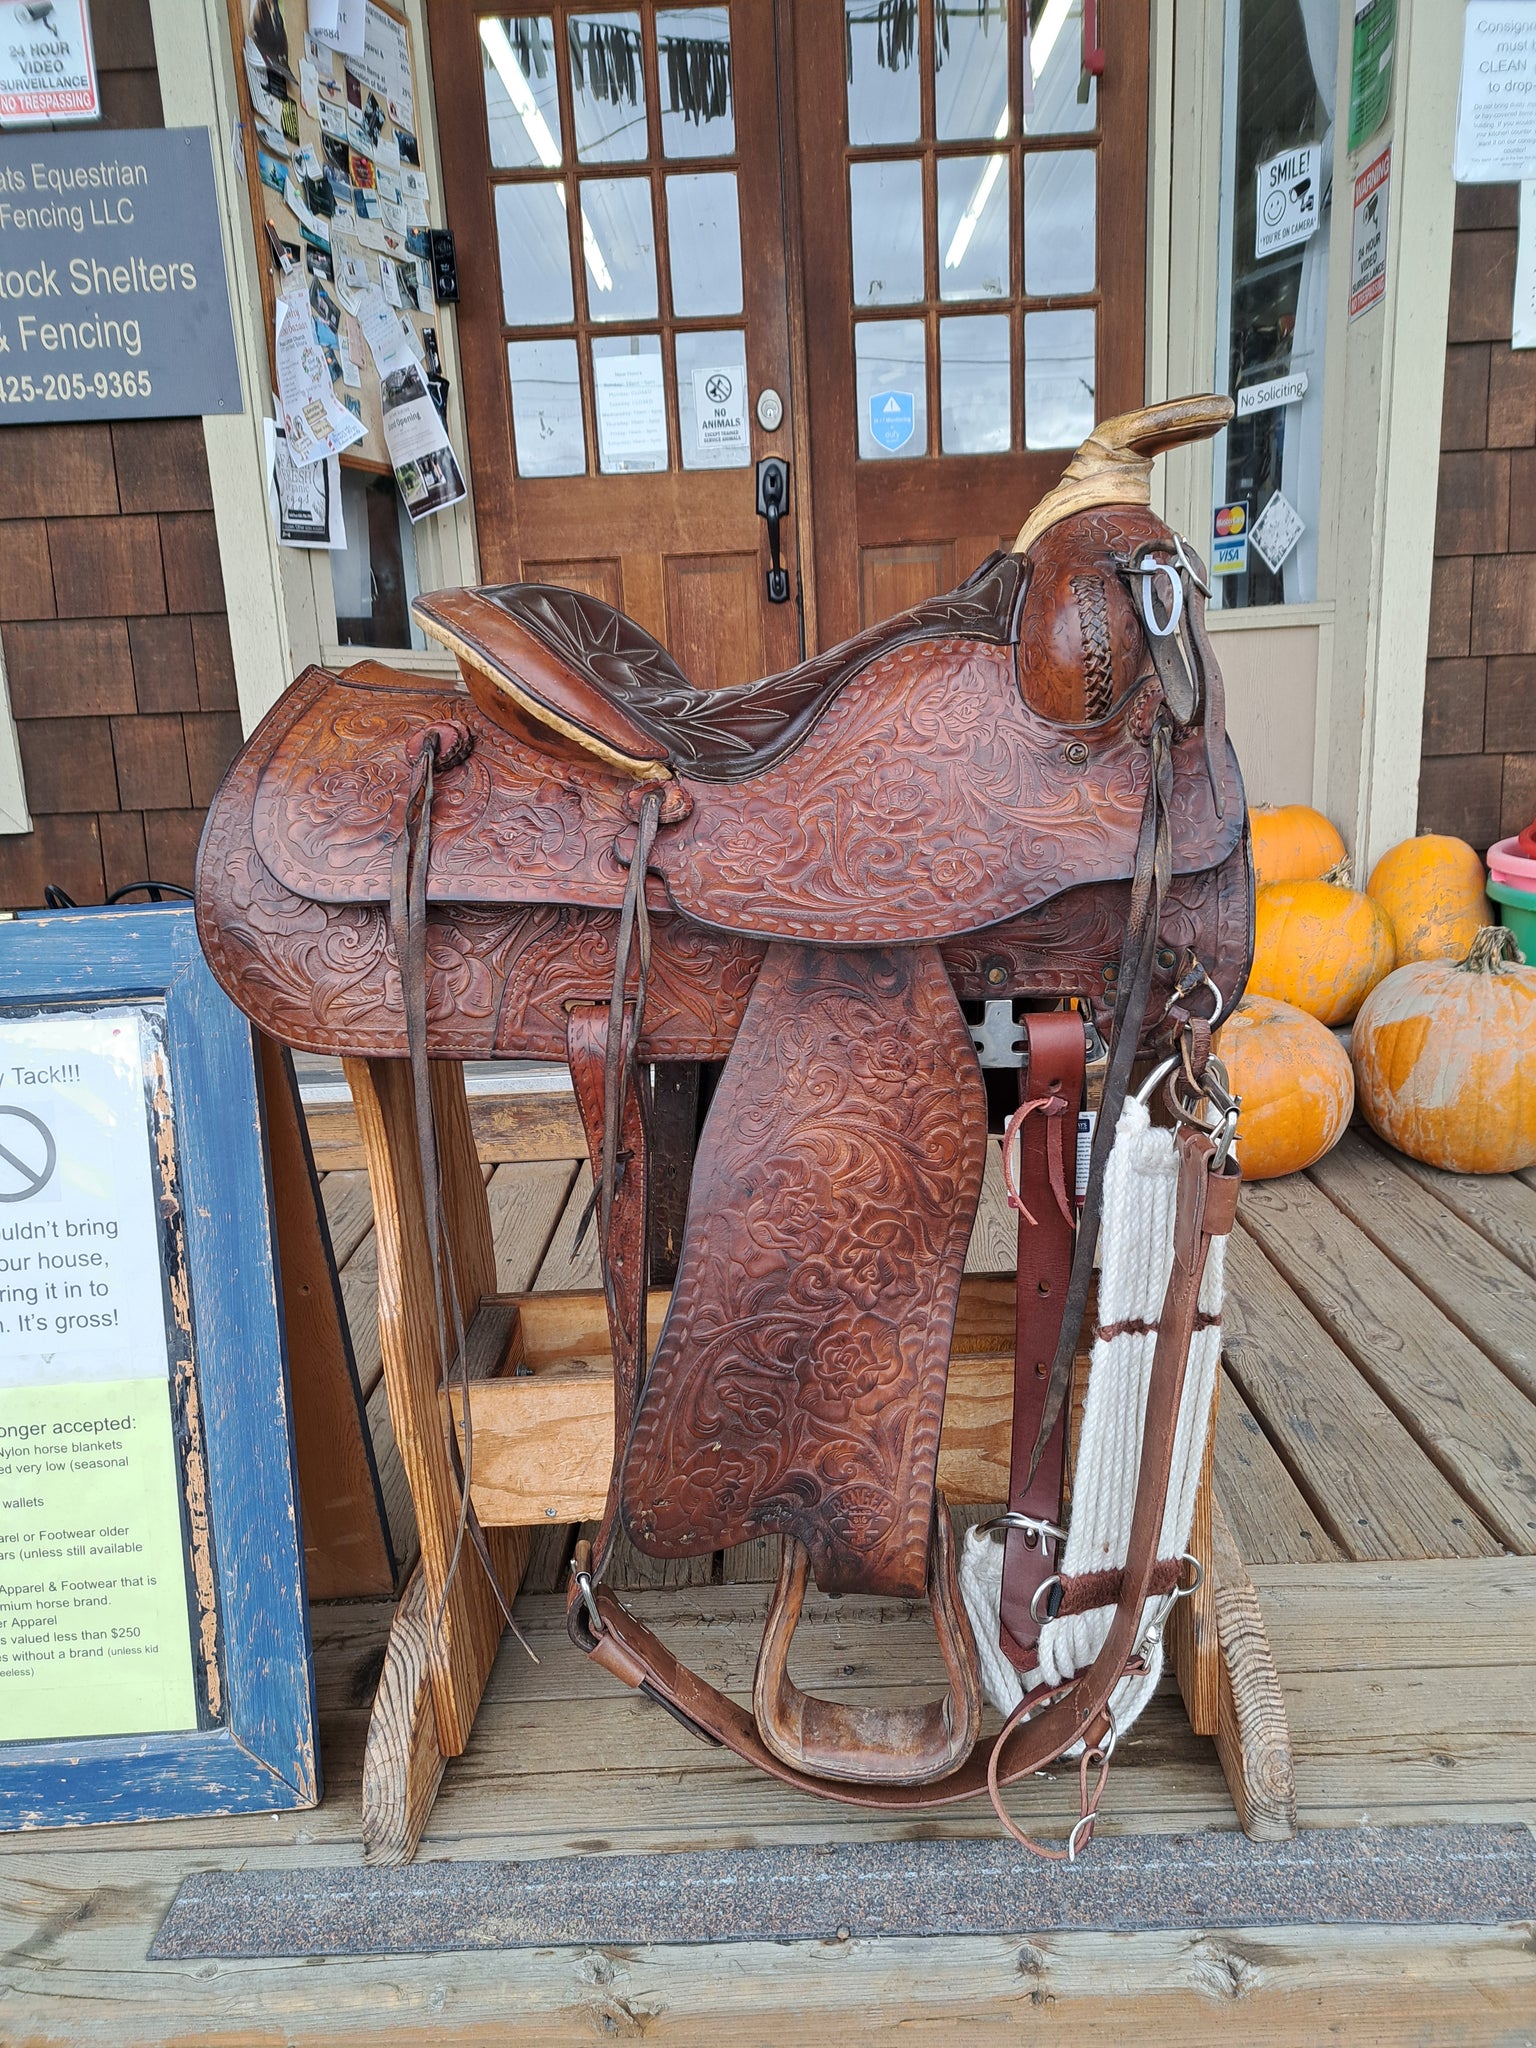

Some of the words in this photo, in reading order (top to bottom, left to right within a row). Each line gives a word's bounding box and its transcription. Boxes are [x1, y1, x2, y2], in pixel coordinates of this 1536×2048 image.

[9, 44, 26, 58] 24
[30, 42, 71, 57] HOUR
[1497, 40, 1527, 52] must
[18, 60, 64, 74] VIDEO
[1480, 60, 1528, 73] CLEAN
[0, 76, 88, 90] SURVEILLANCE
[1489, 81, 1500, 92] to
[1, 96, 16, 113] NO
[18, 92, 92, 113] TRESPASSING
[31, 160, 150, 196] Equestrian
[1270, 150, 1310, 188] SMILE!
[1355, 156, 1390, 202] WARNING
[0, 201, 84, 232] Fencing
[89, 198, 135, 226] LLC
[1358, 248, 1364, 260] 24
[1366, 232, 1381, 254] HOUR
[1360, 252, 1378, 275] VIDEO
[68, 256, 198, 296] Shelters
[1352, 261, 1386, 295] SURVEILLANCE
[18, 312, 142, 357] Fencing
[1241, 395, 1255, 408] No
[1258, 381, 1304, 404] Soliciting
[714, 408, 726, 418] NO
[702, 417, 741, 430] ANIMALS
[1218, 548, 1240, 562] VISA
[11, 1064, 80, 1085] Tack!!!
[66, 1218, 118, 1239] bring
[0, 1256, 31, 1272] our
[38, 1252, 109, 1270] house,
[0, 1284, 38, 1306] ring
[46, 1282, 58, 1300] it
[64, 1281, 82, 1298] in
[89, 1280, 109, 1297] to
[18, 1314, 48, 1332] It's
[55, 1308, 118, 1334] gross!
[0, 1424, 46, 1440] onger
[52, 1415, 136, 1435] accepted:
[34, 1444, 68, 1455] horse
[72, 1440, 122, 1453] blankets
[16, 1464, 42, 1474] very
[46, 1461, 66, 1472] low
[70, 1456, 129, 1472] (seasonal
[2, 1497, 44, 1508] wallets
[0, 1532, 20, 1543] arel
[23, 1534, 36, 1542] or
[39, 1529, 96, 1541] Footwear
[100, 1526, 130, 1537] older
[20, 1548, 63, 1561] (unless
[66, 1544, 86, 1556] still
[90, 1542, 144, 1556] available
[0, 1582, 44, 1596] Apparel
[48, 1581, 58, 1592] &
[61, 1579, 118, 1591] Footwear
[120, 1576, 144, 1587] that
[147, 1576, 158, 1586] is
[0, 1600, 32, 1612] mium
[36, 1599, 70, 1610] horse
[74, 1595, 112, 1608] brand.
[12, 1615, 58, 1628] Apparel
[10, 1632, 50, 1644] valued
[54, 1631, 78, 1642] less
[81, 1629, 108, 1641] than
[110, 1626, 141, 1640] $250
[12, 1650, 55, 1662] without
[58, 1650, 66, 1659] a
[70, 1646, 104, 1659] brand
[108, 1646, 142, 1658] (unless
[144, 1644, 159, 1654] kid
